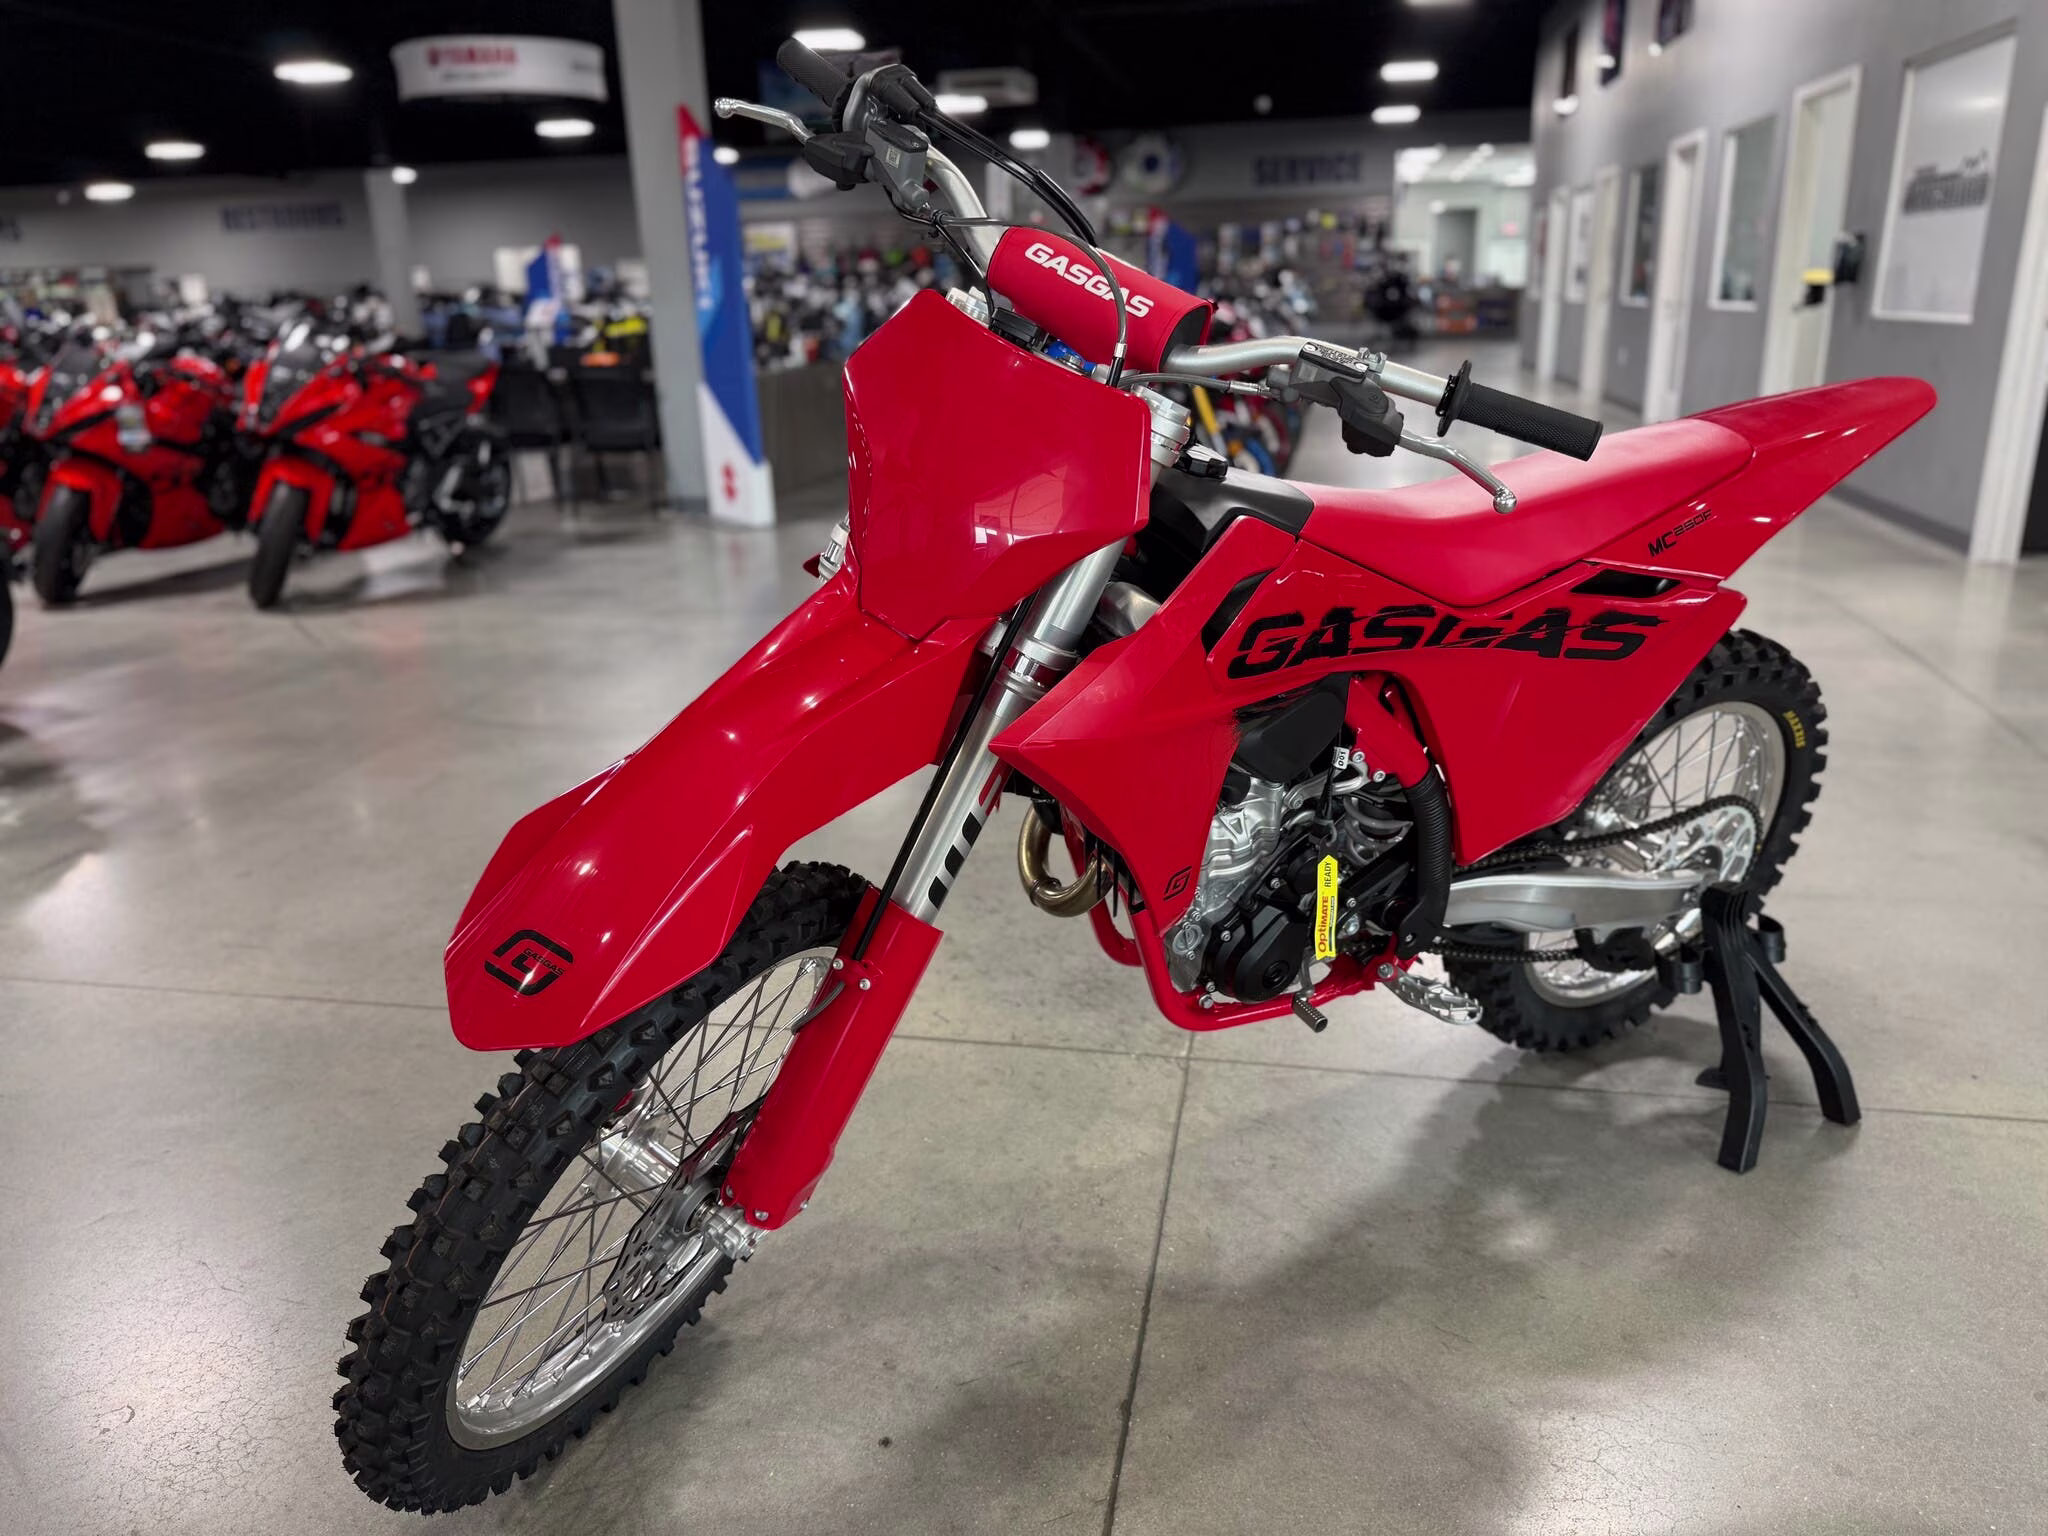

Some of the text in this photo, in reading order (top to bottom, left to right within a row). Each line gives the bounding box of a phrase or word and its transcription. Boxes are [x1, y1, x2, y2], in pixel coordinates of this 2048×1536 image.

[1255, 154, 1361, 185] SERVICE
[1025, 243, 1154, 318] GASGAS
[1228, 605, 1671, 679] GASGAS
